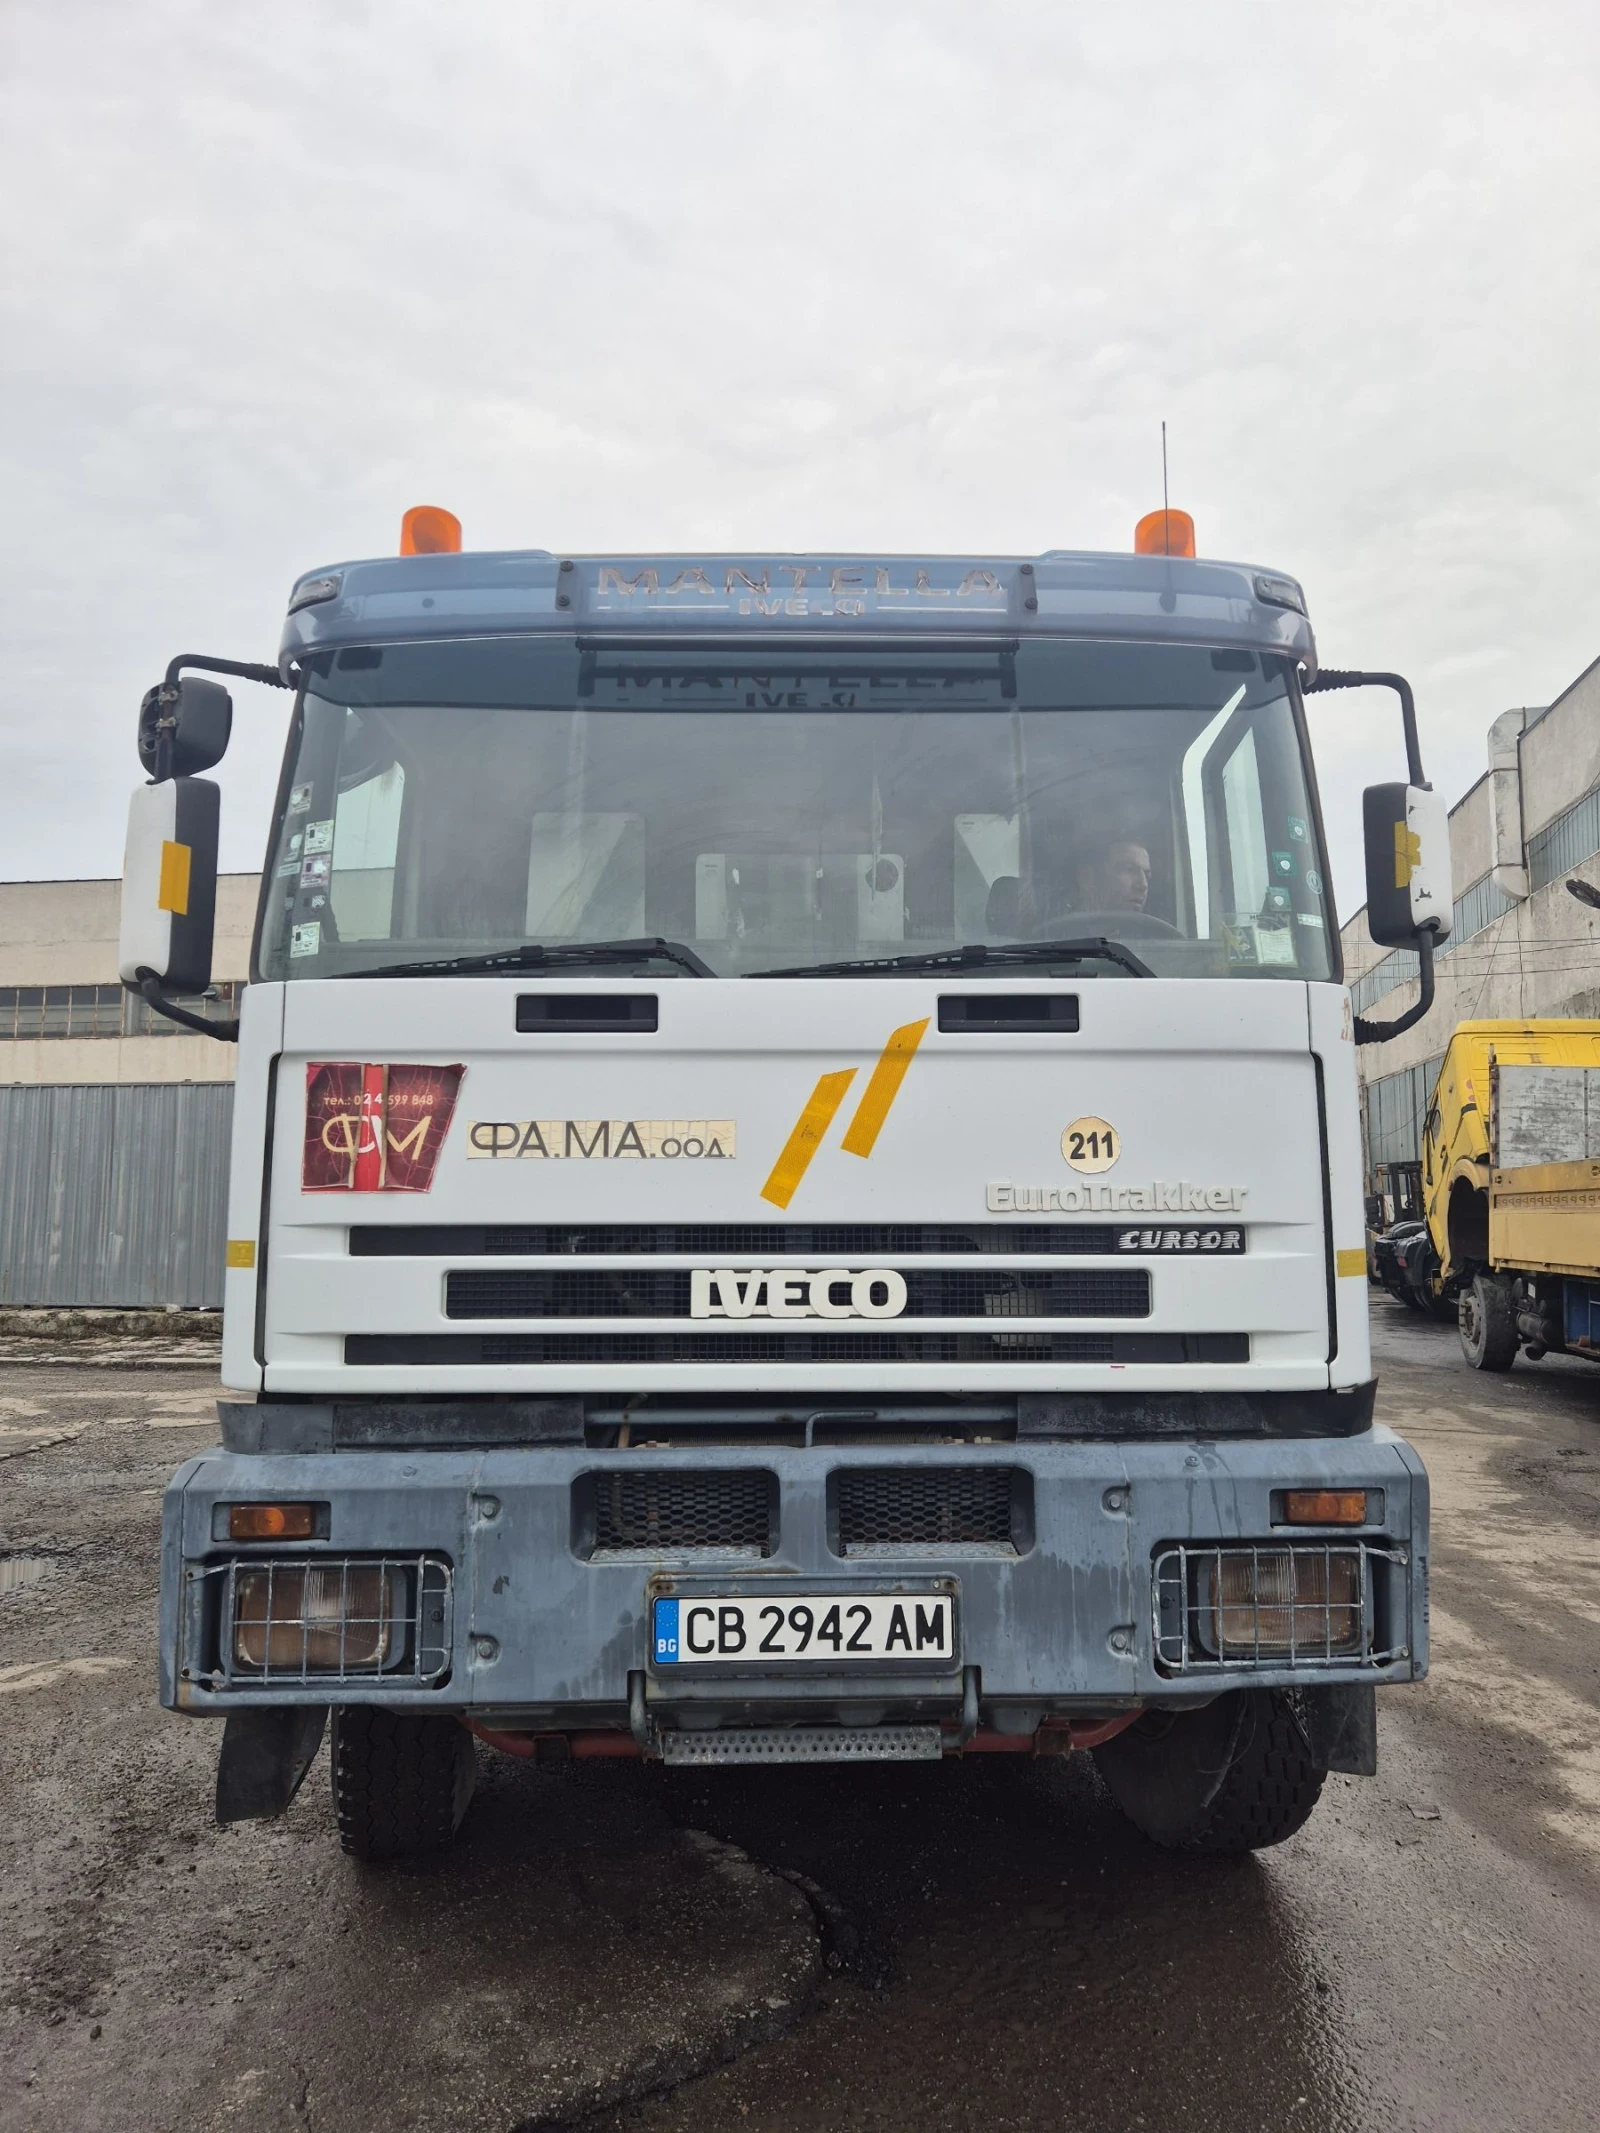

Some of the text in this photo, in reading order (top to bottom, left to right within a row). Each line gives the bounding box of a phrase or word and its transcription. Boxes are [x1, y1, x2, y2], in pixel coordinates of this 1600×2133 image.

[597, 565, 1003, 596] MANTELLA
[739, 598, 865, 616] IVEO
[388, 1094, 408, 1106] 599
[411, 1094, 434, 1106] 848
[1068, 1131, 1114, 1160] 211
[985, 1181, 1249, 1213] EuroTrakker
[1117, 1229, 1241, 1250] CURSOR
[690, 1269, 908, 1319] IVECO
[686, 1603, 945, 1655] CB 2942 AM
[657, 1638, 677, 1654] BG
